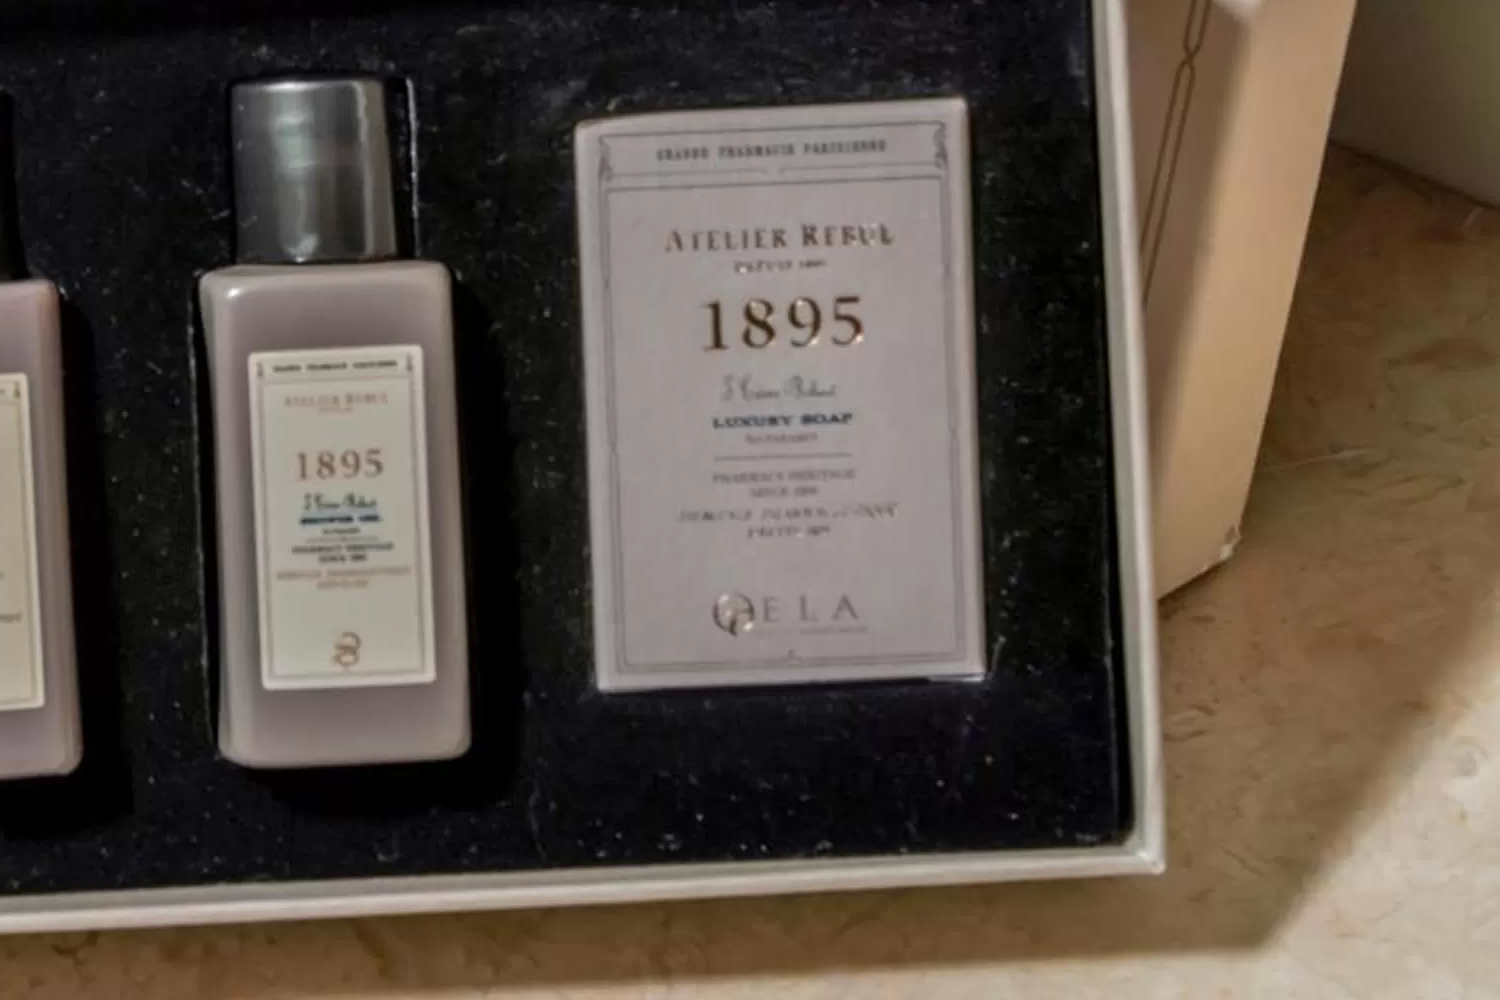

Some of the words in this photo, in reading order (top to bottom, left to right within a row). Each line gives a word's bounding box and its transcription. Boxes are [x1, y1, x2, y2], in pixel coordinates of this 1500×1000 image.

[664, 229, 788, 252] ATELIER
[802, 224, 896, 247] REBUL
[703, 295, 865, 353] 1895
[712, 414, 794, 430] LUXURY
[801, 411, 853, 426] SOAP
[297, 447, 384, 482] 1895
